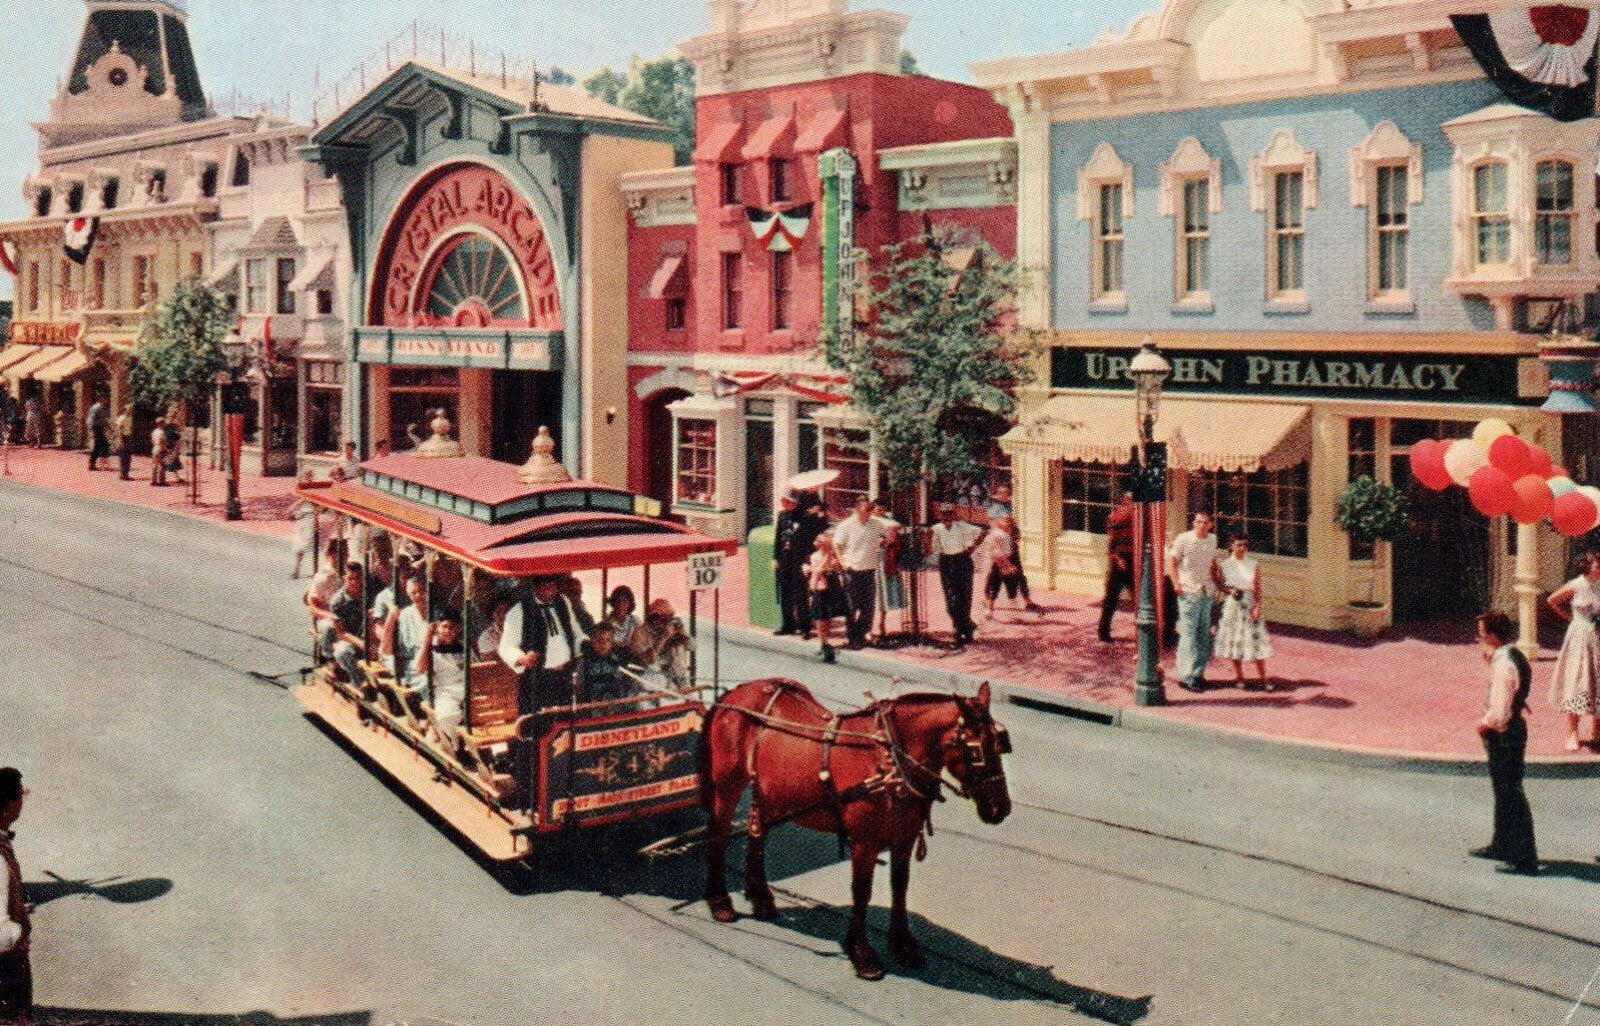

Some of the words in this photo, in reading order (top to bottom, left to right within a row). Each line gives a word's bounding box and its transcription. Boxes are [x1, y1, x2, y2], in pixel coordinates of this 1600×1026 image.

[388, 179, 469, 317] CRYSTAL
[474, 178, 556, 317] ARCADE
[1085, 351, 1226, 384] UPHN
[1245, 355, 1467, 391] PHARMACY
[693, 556, 722, 568] FARE
[579, 720, 681, 748] DISNEYLAND
